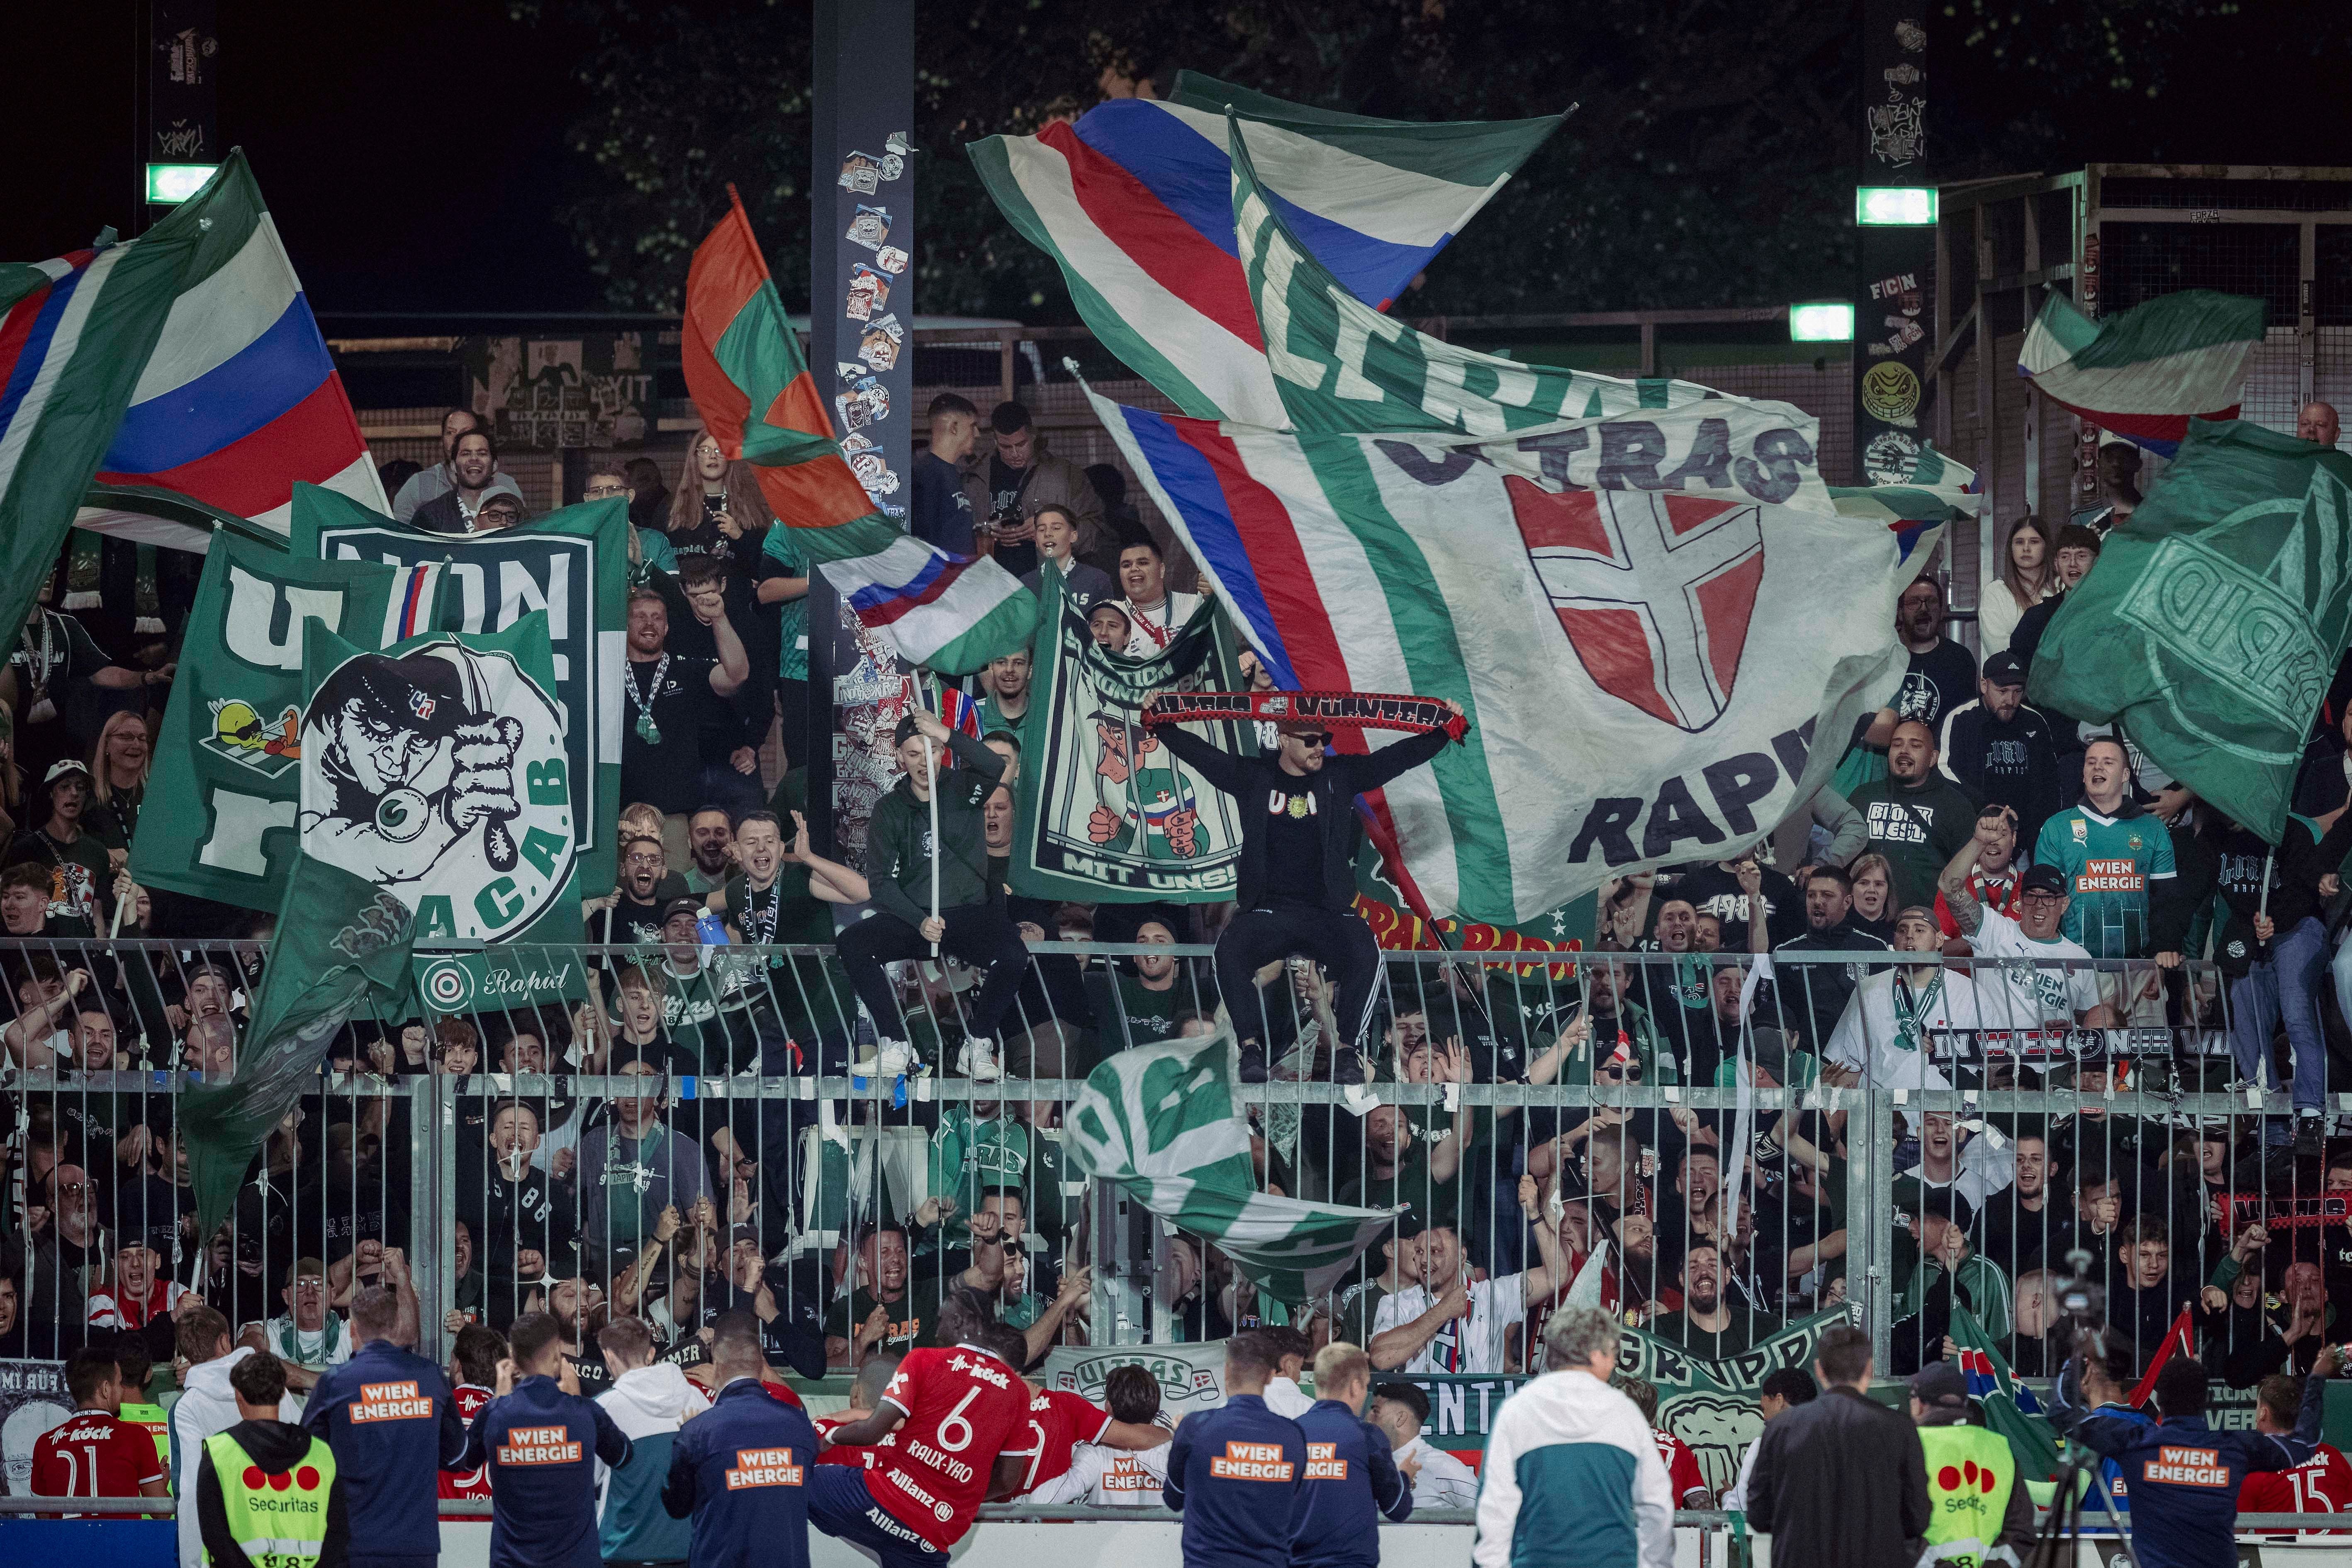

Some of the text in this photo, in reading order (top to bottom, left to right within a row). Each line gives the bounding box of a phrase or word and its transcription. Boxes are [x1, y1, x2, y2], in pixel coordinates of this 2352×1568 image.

[1870, 273, 1917, 299] FCN
[1062, 852, 1237, 891] MIT UNS!
[2088, 861, 2133, 874] WIEN
[2078, 876, 2143, 890] ENERGIE
[484, 964, 570, 1001] Rapid
[1933, 1033, 1971, 1058] IN
[1976, 1030, 2065, 1057] WIEN
[2106, 1028, 2172, 1054] NUR
[365, 1383, 416, 1401] WIEN
[353, 1401, 430, 1420] ENERGIE
[937, 1385, 982, 1452] 6
[513, 1429, 564, 1445] WIEN
[500, 1445, 579, 1463] ENERGIE
[740, 1451, 790, 1466] WIEN
[907, 1439, 973, 1484] RAUX-YAO
[1230, 1444, 1280, 1462] WIEN
[2164, 1449, 2215, 1467] WIEN
[729, 1468, 801, 1488] ENERGIE
[1214, 1461, 1293, 1479] ENERGIE
[2147, 1465, 2227, 1485] ENERGIE
[56, 1445, 98, 1519] 21
[886, 1467, 936, 1509] Allianz
[248, 1497, 319, 1513] Securitas
[2286, 1468, 2335, 1536] 15
[865, 1506, 922, 1544] Allianz
